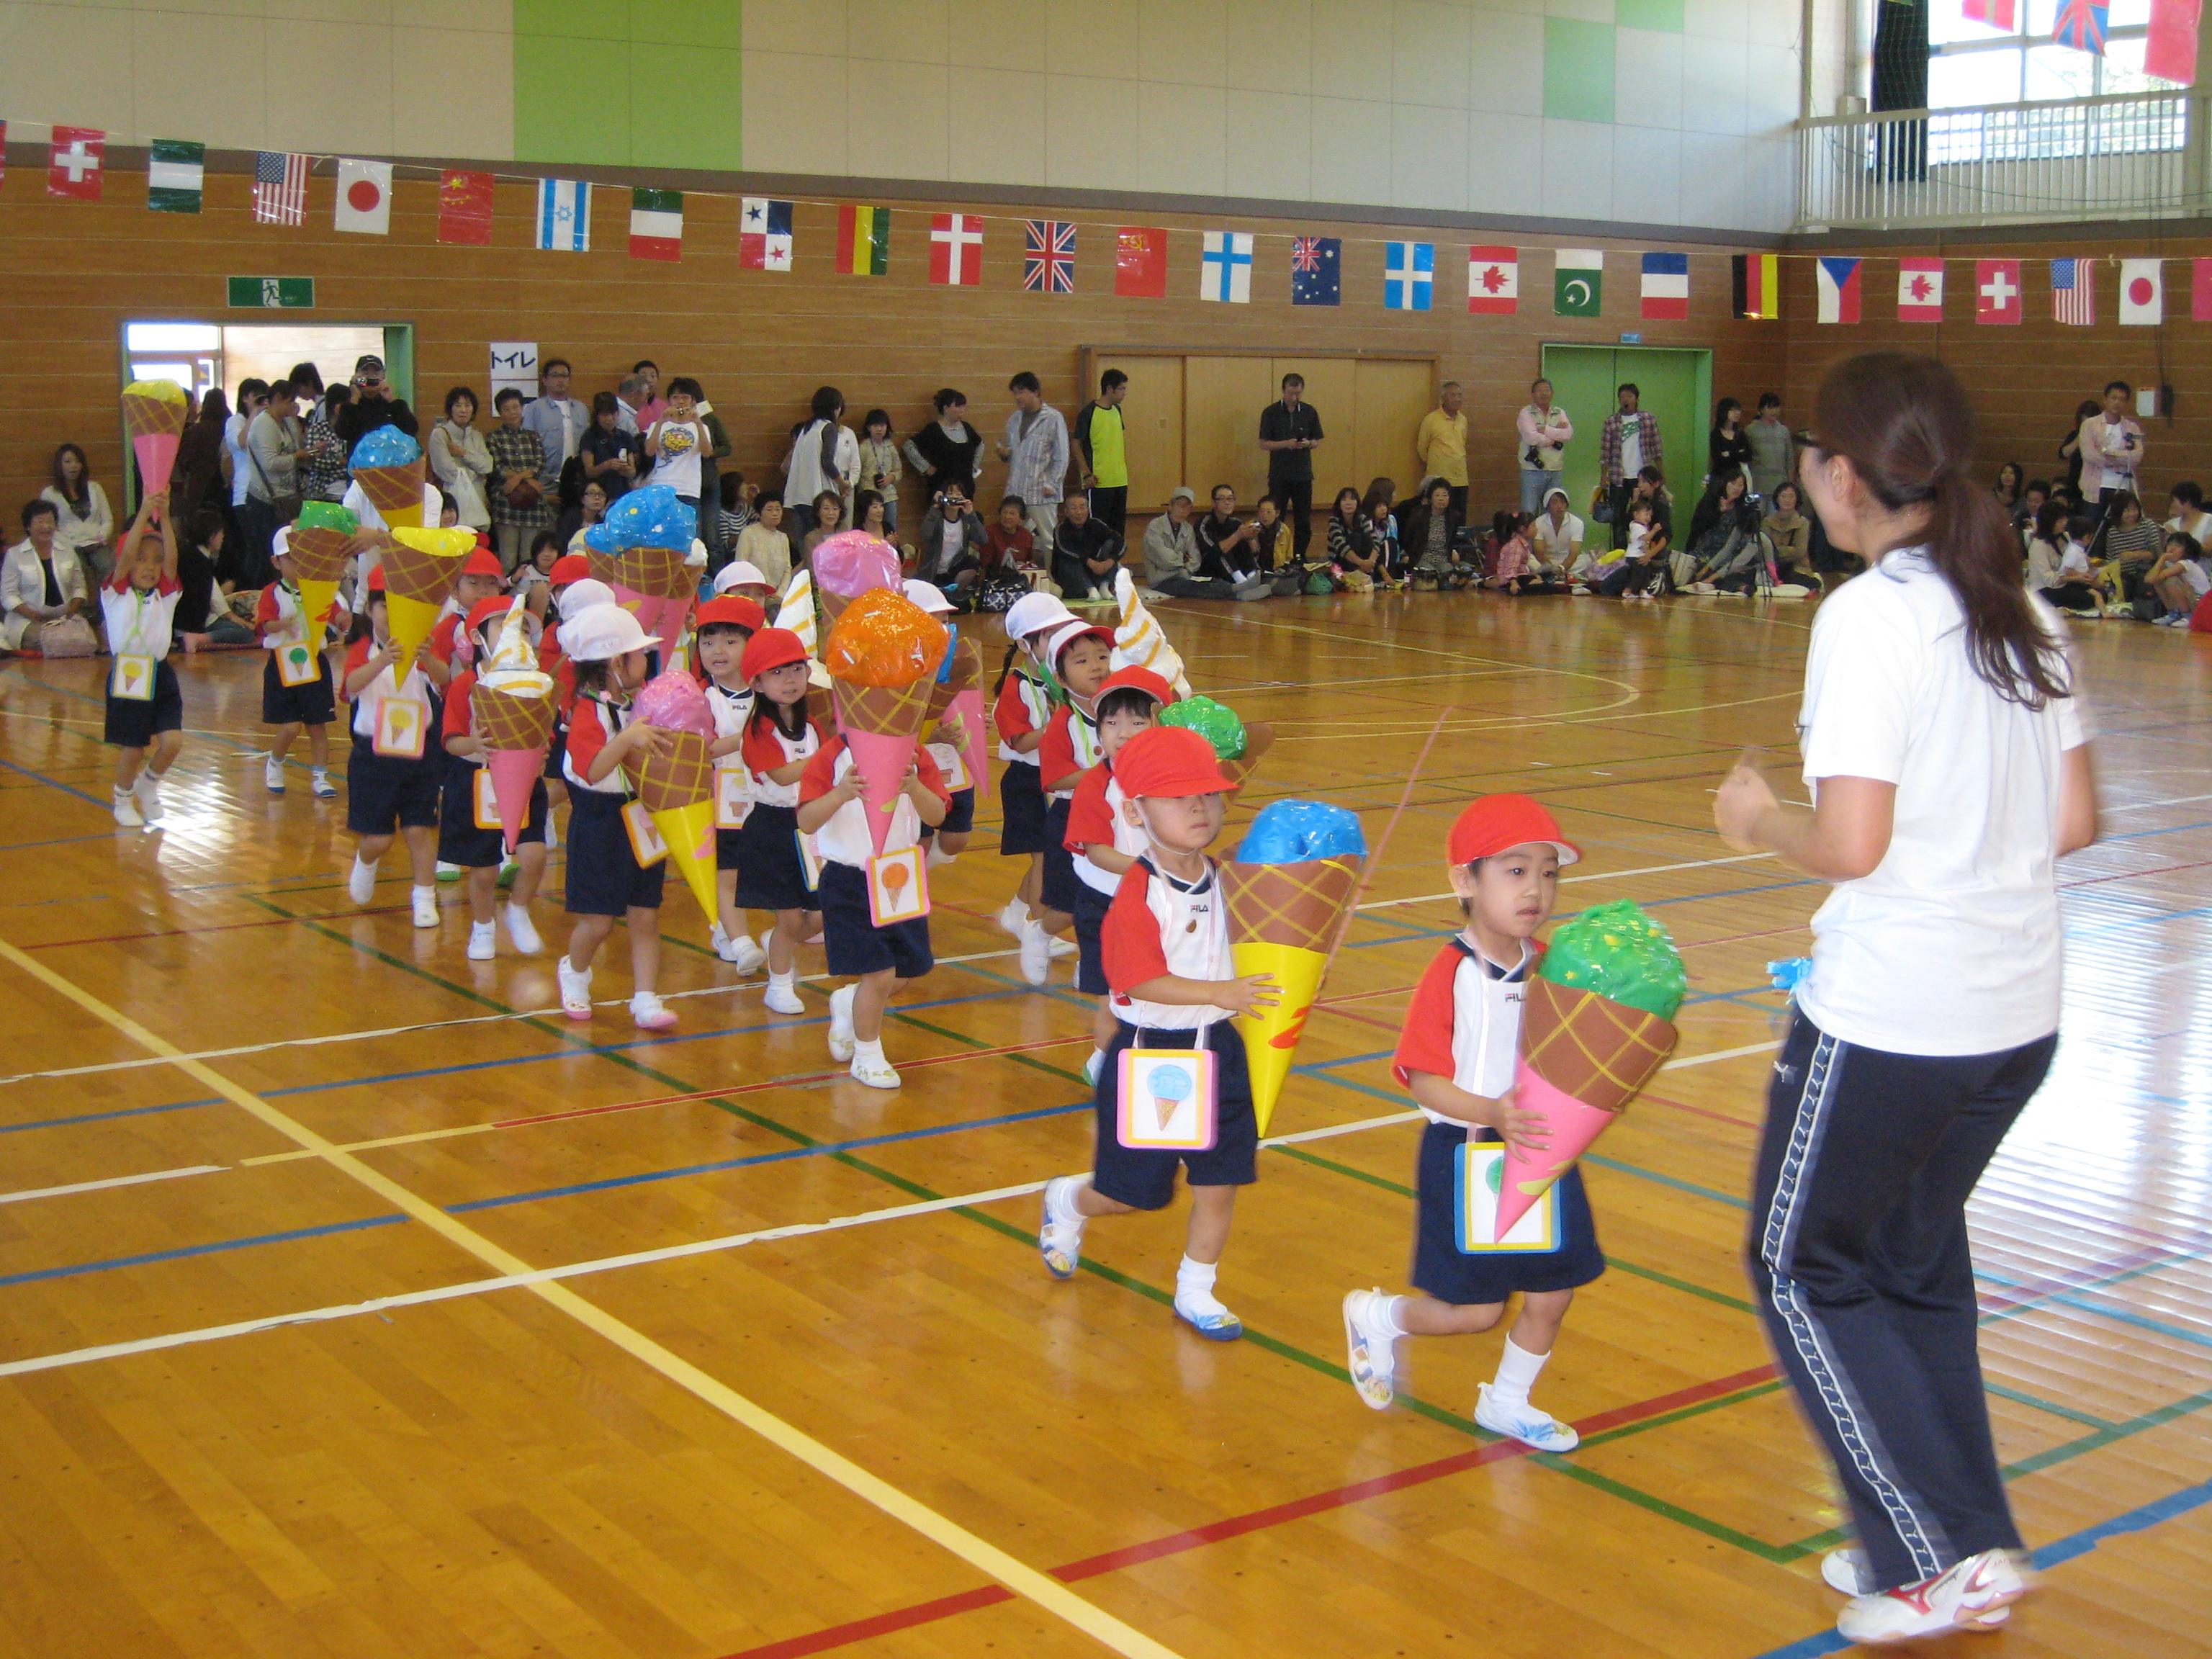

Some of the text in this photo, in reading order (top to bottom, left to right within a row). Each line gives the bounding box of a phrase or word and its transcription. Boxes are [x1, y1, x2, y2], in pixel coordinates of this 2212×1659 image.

[491, 351, 536, 369] トイレ
[1190, 904, 1209, 913] FILA
[1505, 993, 1525, 1002] FIL
